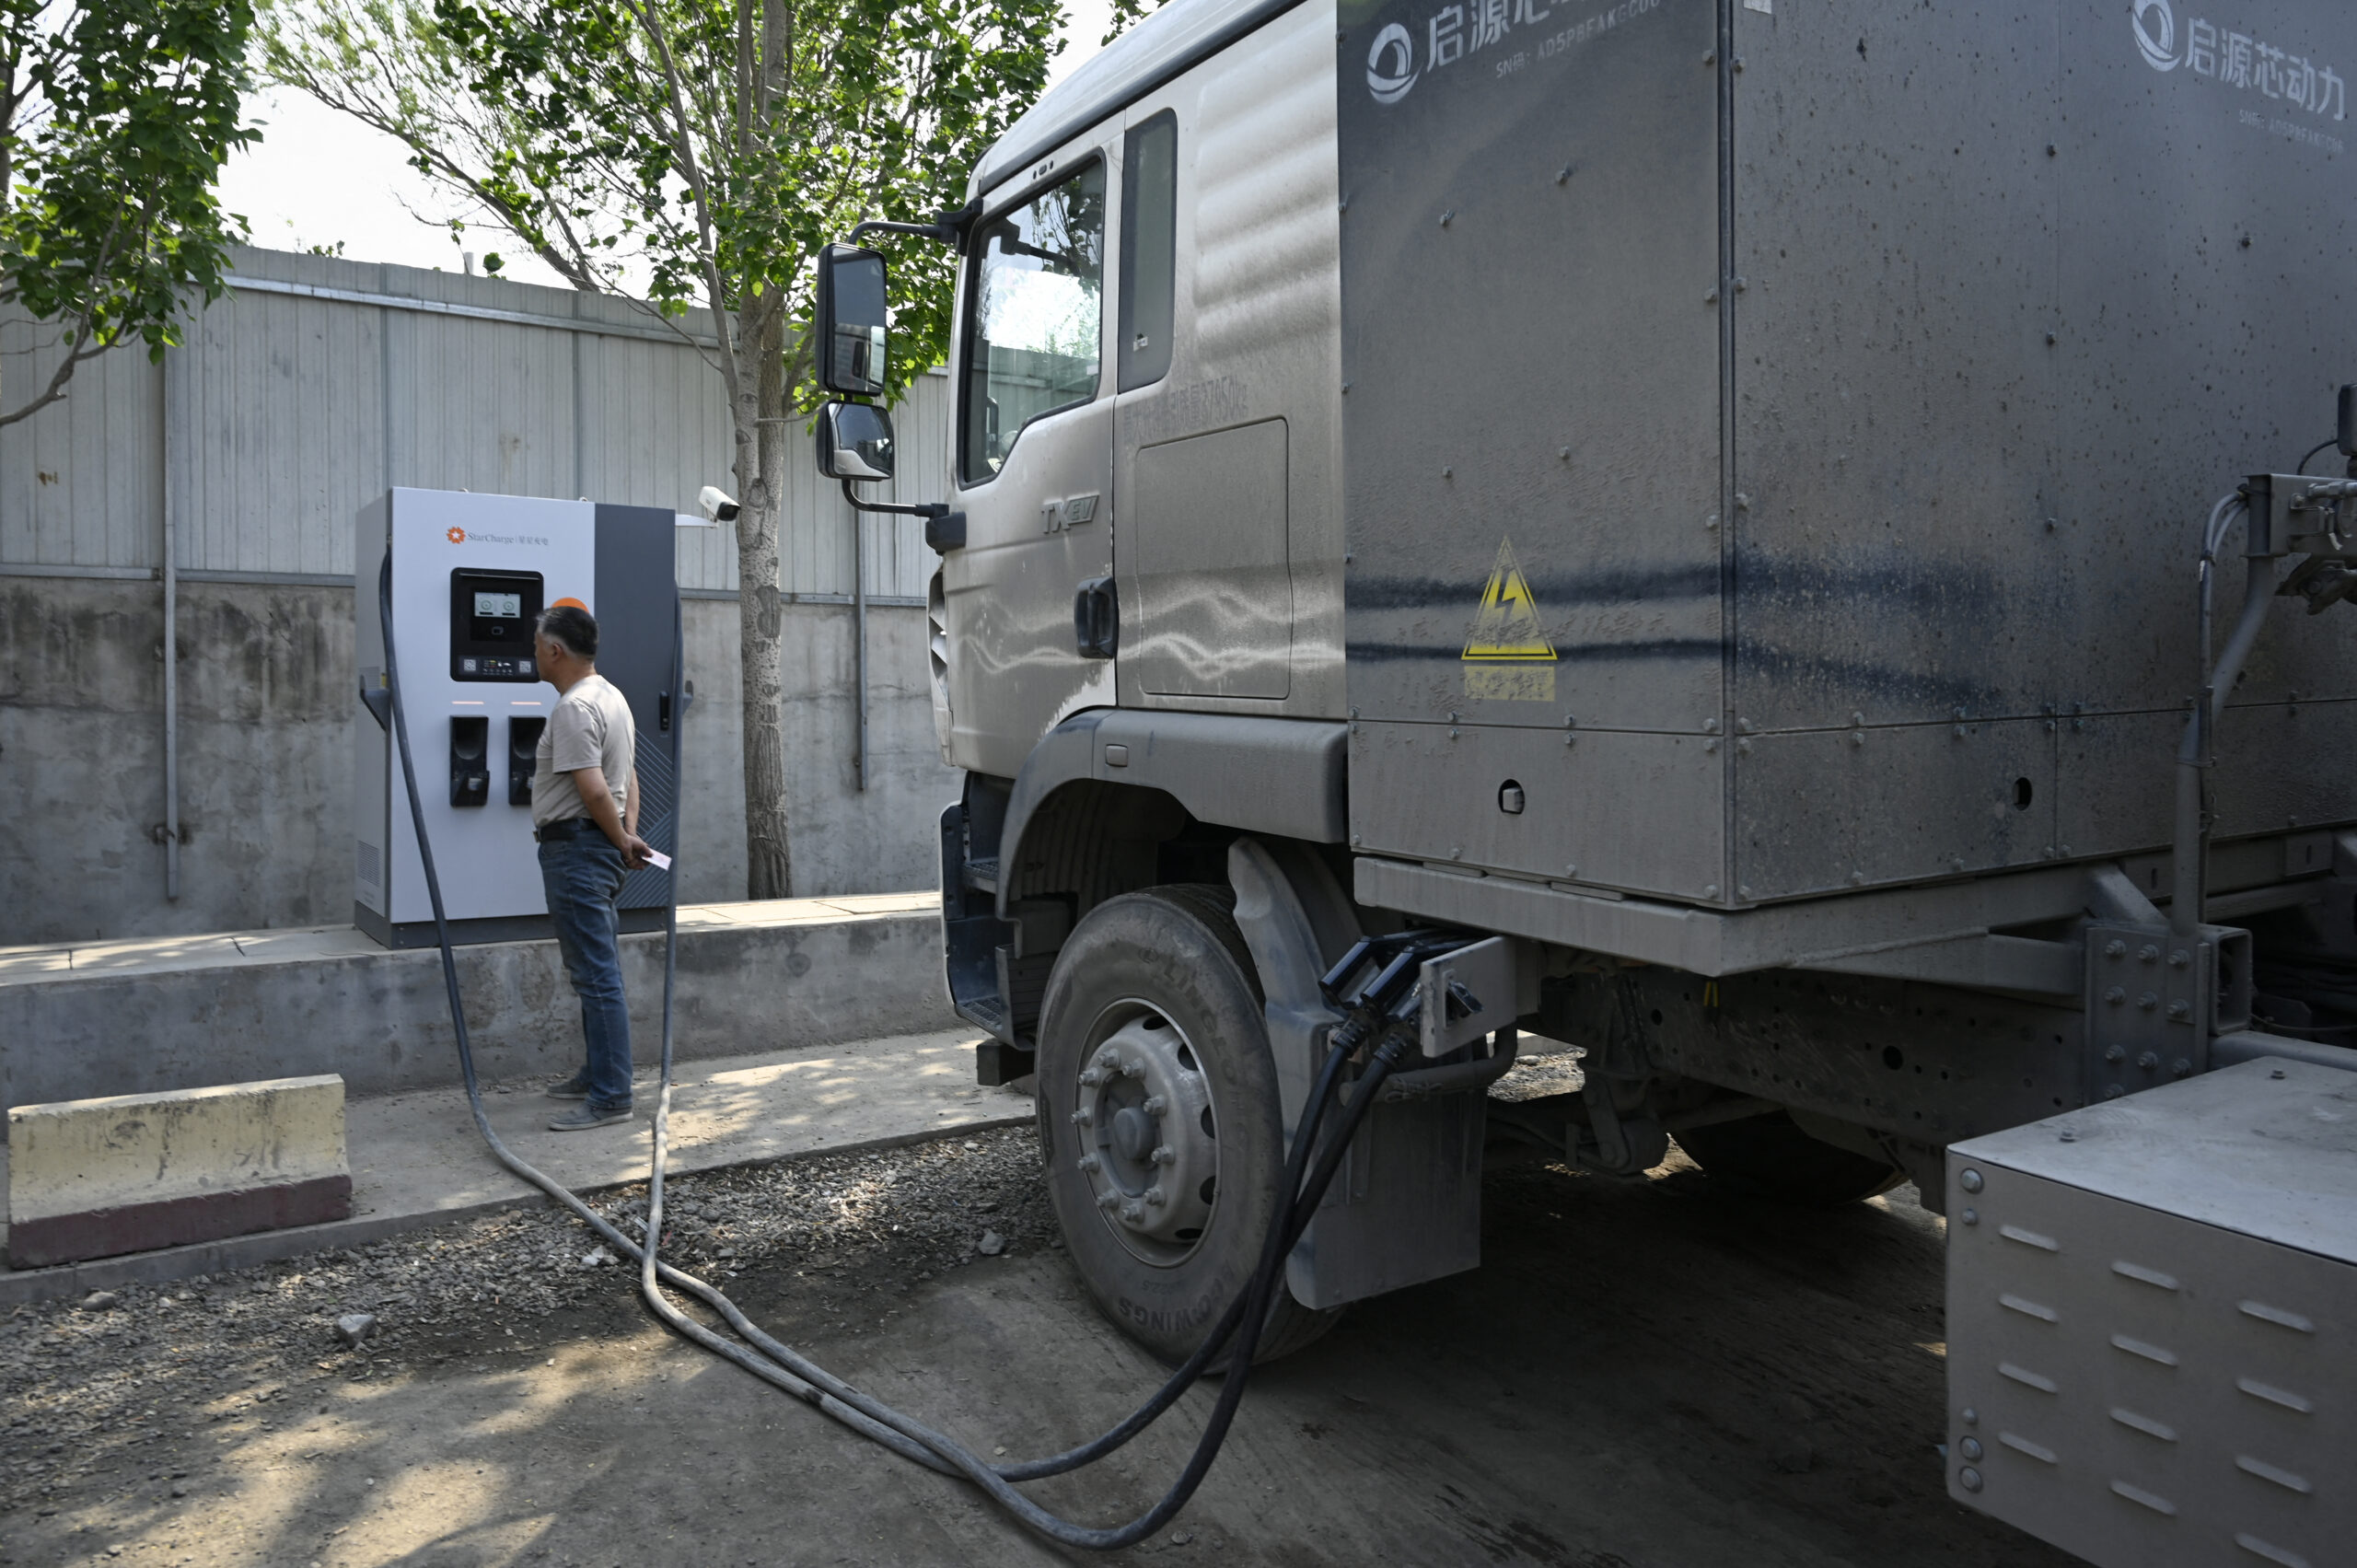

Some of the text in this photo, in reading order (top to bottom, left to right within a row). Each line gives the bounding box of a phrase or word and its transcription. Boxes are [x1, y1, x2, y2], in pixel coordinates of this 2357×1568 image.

[2185, 17, 2344, 122] 启源芯动力
[468, 533, 515, 545] StarCharge
